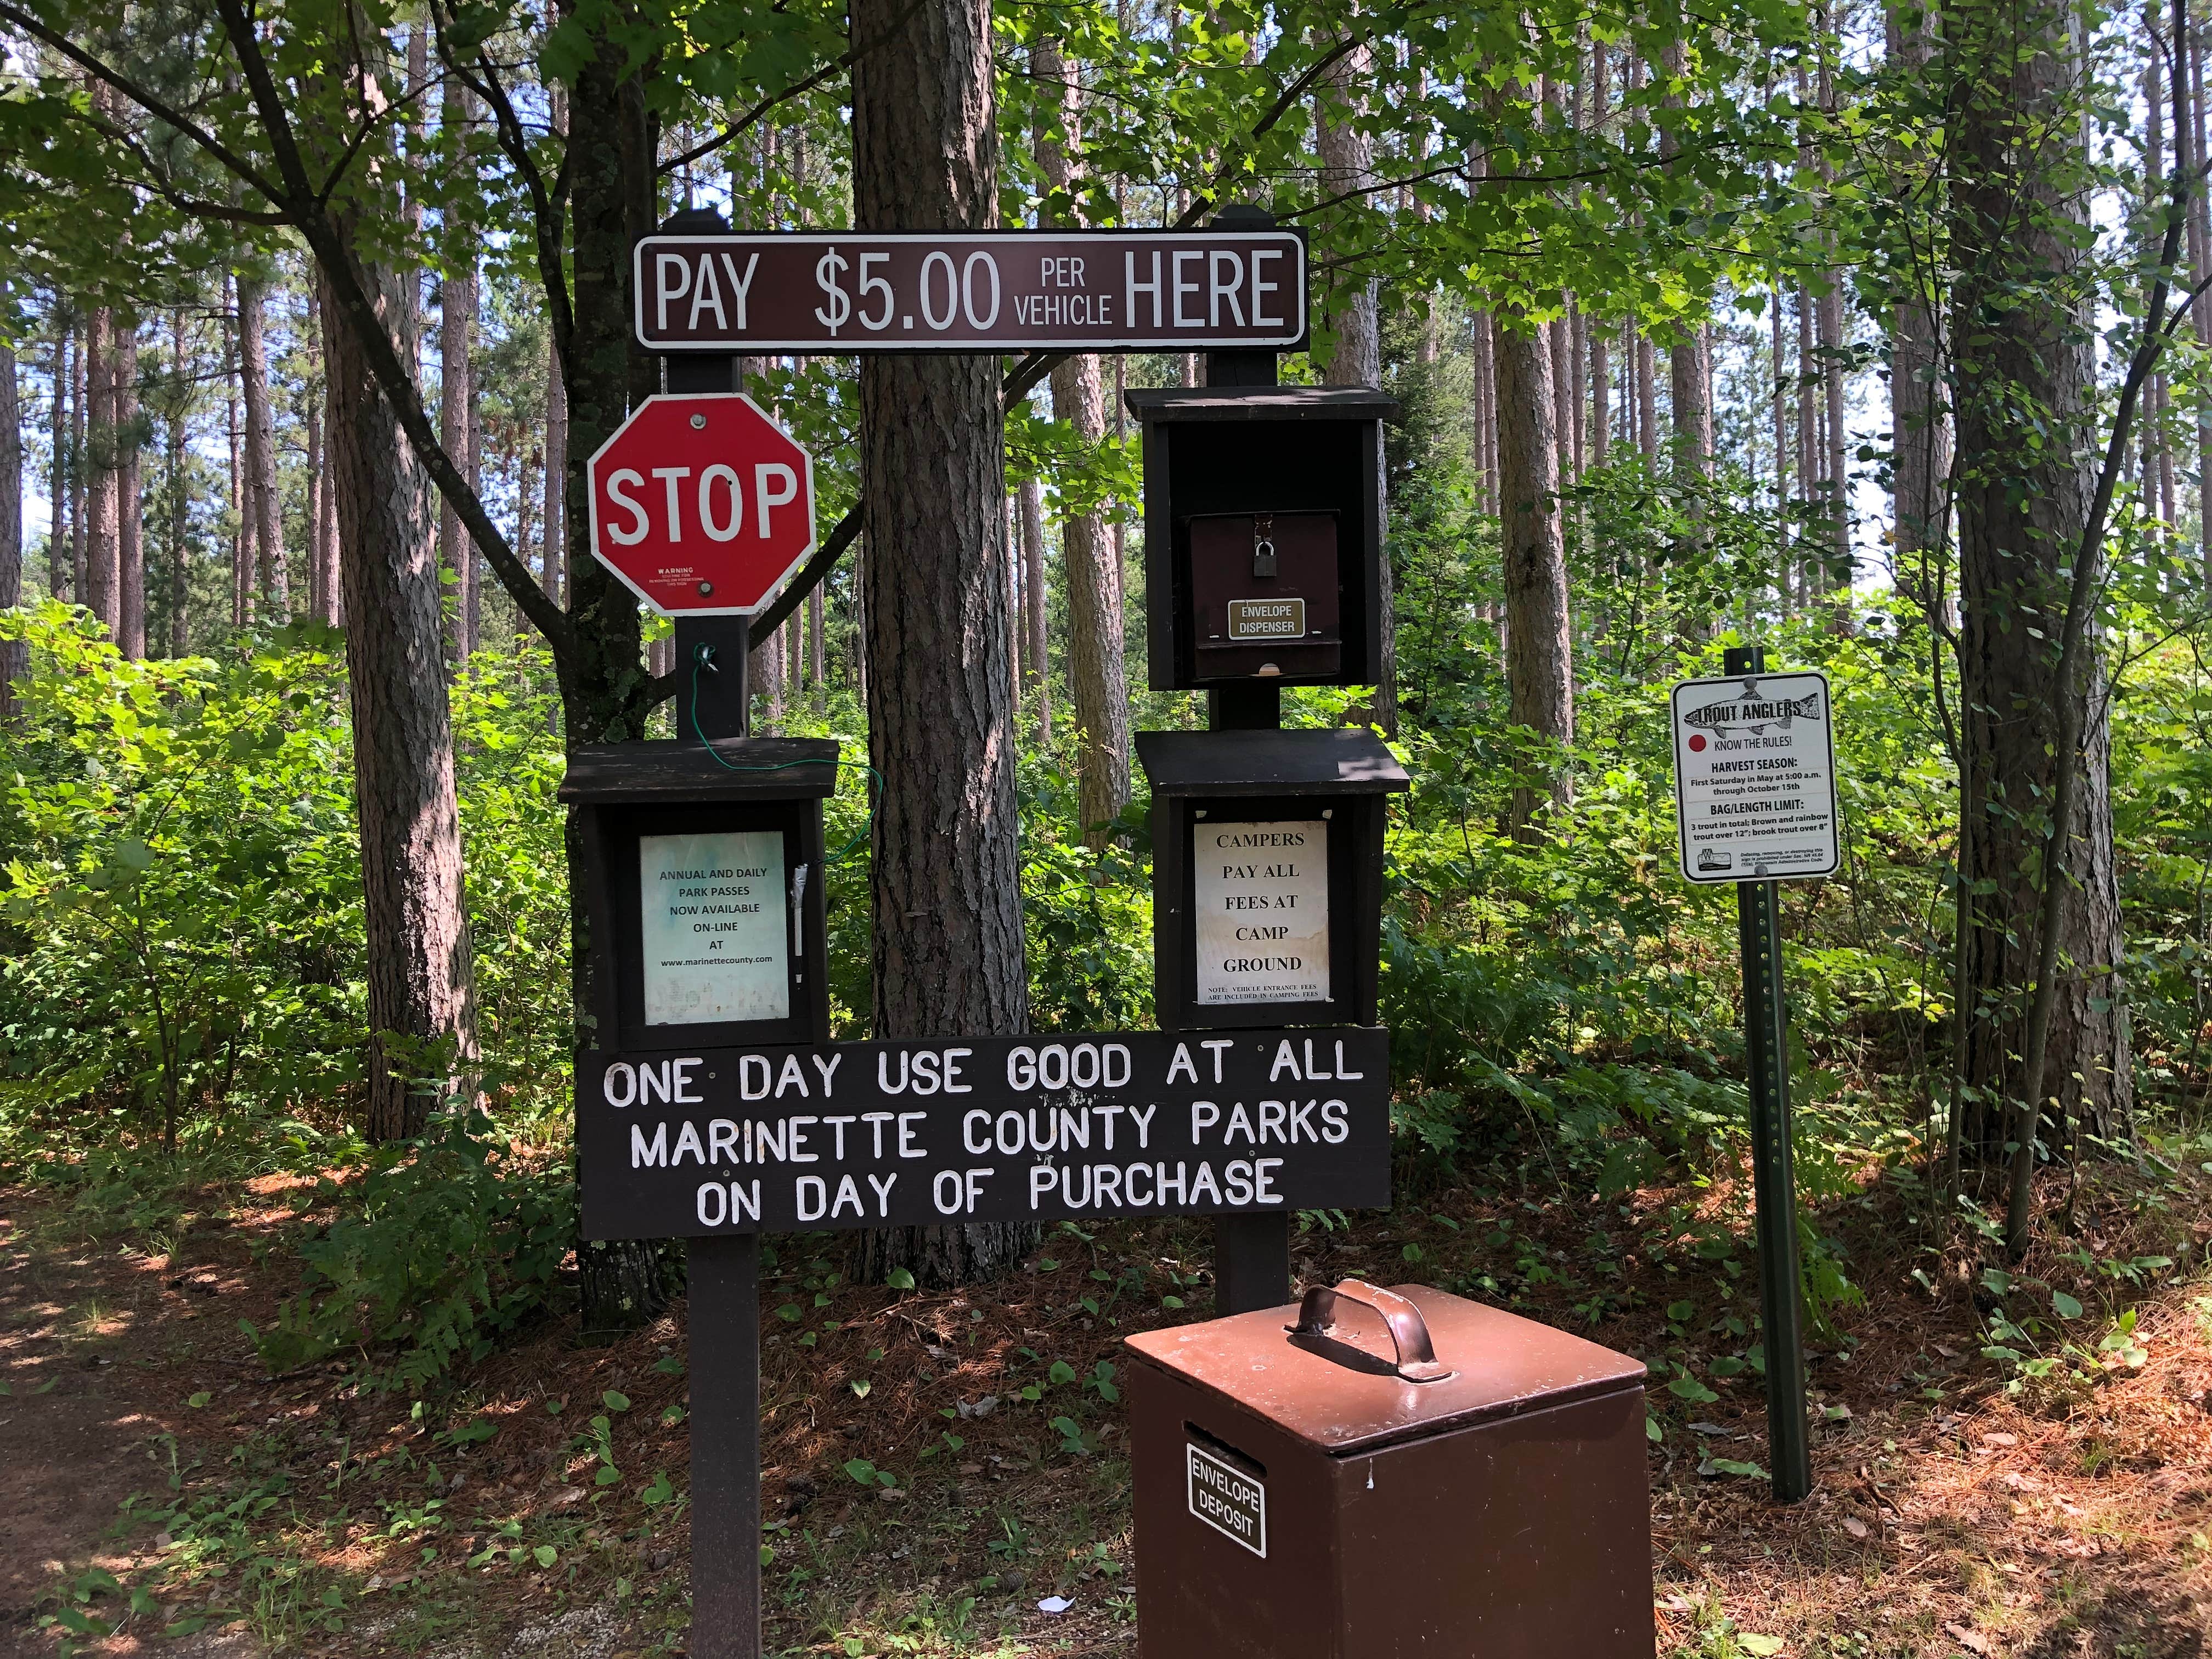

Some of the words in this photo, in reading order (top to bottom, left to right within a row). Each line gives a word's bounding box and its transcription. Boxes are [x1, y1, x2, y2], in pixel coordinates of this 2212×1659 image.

[1041, 257, 1085, 287] PER
[656, 253, 759, 330] PAY
[815, 246, 1001, 336] $5.00
[1125, 250, 1283, 328] HERE
[1014, 295, 1113, 325] VEHICLE
[607, 463, 797, 545] STOP
[1242, 606, 1291, 617] ENVELOPE
[1240, 621, 1295, 633] DISPENSER
[1696, 706, 1737, 723] TROUT
[1742, 701, 1801, 720] ANGLERS
[1715, 739, 1742, 751] KNOW
[1743, 738, 1760, 749] THE
[1763, 736, 1792, 747] RULES!
[1712, 760, 1754, 773] HARVEST
[1757, 757, 1798, 770] SEASON:
[1691, 778, 1708, 786] First
[1710, 776, 1745, 785] Saturday
[1757, 774, 1773, 783] May
[1713, 787, 1745, 795] through
[1747, 785, 1780, 793] October
[1782, 782, 1799, 791] 15th
[1711, 801, 1772, 815] BAG/LENGTH
[1774, 799, 1804, 811] LIMIT:
[1698, 822, 1717, 830] trout
[1751, 817, 1777, 826] Brown
[1796, 813, 1829, 822] rainbow
[1216, 833, 1304, 848] CAMPERS
[1694, 832, 1713, 840] trout
[1753, 827, 1776, 836] brook
[1778, 826, 1798, 834] trout
[659, 870, 706, 880] ANNUAL
[709, 869, 733, 878] AND
[737, 868, 767, 877] DAILY
[1222, 865, 1258, 879] PAY
[1263, 864, 1300, 877] ALL
[679, 888, 708, 897] PARK
[711, 887, 749, 896] PASSES
[670, 906, 698, 915] NOW
[702, 904, 759, 915] AVAILABLE
[1225, 896, 1268, 910] FEES
[1273, 895, 1298, 909] AT
[693, 922, 738, 932] ON-LINE
[1236, 927, 1289, 940] CAMP
[709, 940, 723, 950] AT
[661, 956, 772, 966] www.marinettecounty.com
[1224, 957, 1301, 972] GROUND
[604, 1057, 704, 1108] ONE
[740, 1053, 842, 1101] DAY
[878, 1048, 973, 1095] USE
[1007, 1043, 1131, 1091] GOOD
[1166, 1040, 1234, 1085] AT
[1270, 1039, 1364, 1082] ALL
[631, 1111, 928, 1169] MARINETTE
[963, 1104, 1156, 1155] COUNTY
[1192, 1099, 1350, 1146] PARKS
[697, 1180, 761, 1227] ON
[797, 1172, 897, 1222] DAY
[934, 1168, 994, 1215] OF
[1030, 1158, 1284, 1210] PURCHASE
[1193, 1457, 1259, 1513] ENVELOPE
[1199, 1488, 1253, 1537] DEPOSIT
